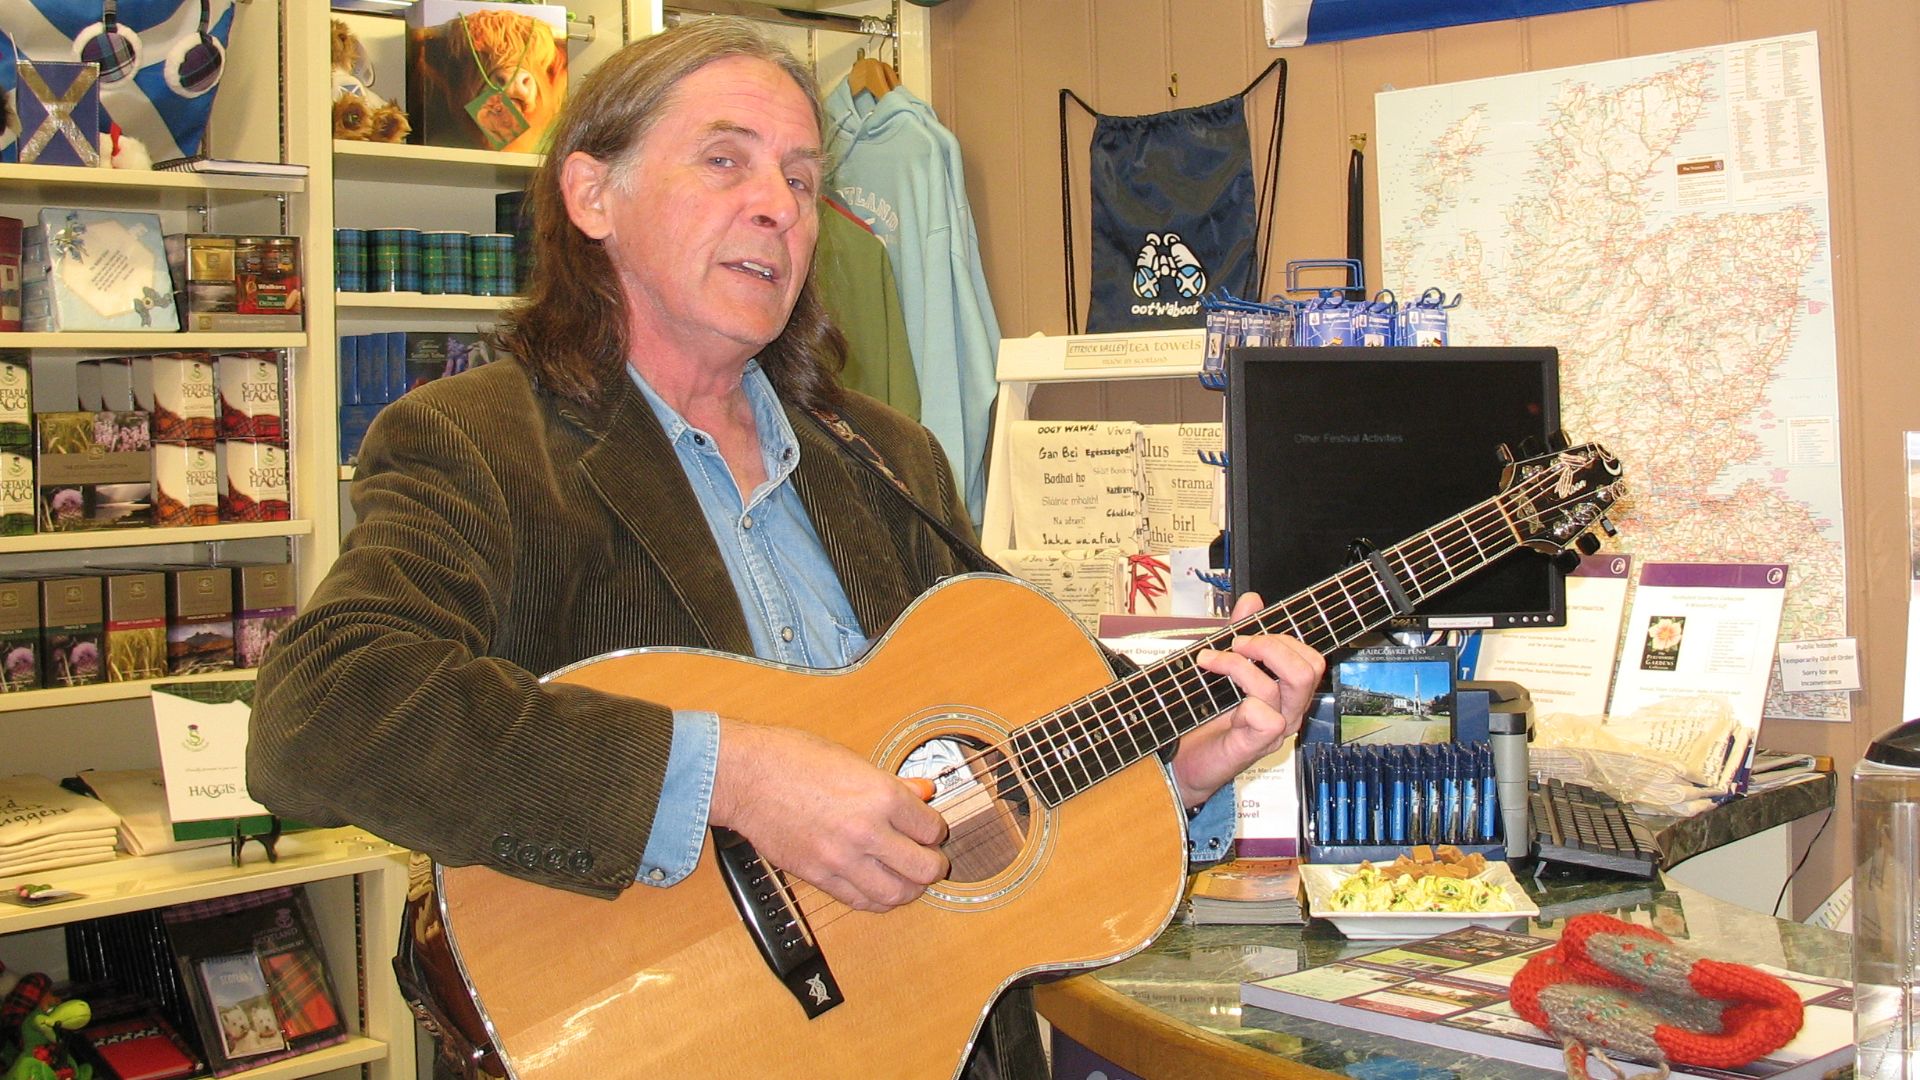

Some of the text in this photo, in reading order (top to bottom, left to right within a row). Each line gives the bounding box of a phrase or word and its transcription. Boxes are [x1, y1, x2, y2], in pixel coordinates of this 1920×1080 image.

[836, 187, 899, 232] TLAND
[1037, 425, 1061, 435] OOGY
[1039, 446, 1059, 459] Gan
[1062, 445, 1079, 458] Bei
[1171, 477, 1214, 490] strama
[1172, 513, 1196, 532] birl
[1390, 617, 1420, 628] DELL
[1135, 647, 1166, 656] Dougie
[188, 783, 237, 799] HAGGIS
[1241, 799, 1260, 808] CDs
[1237, 810, 1260, 819] owel
